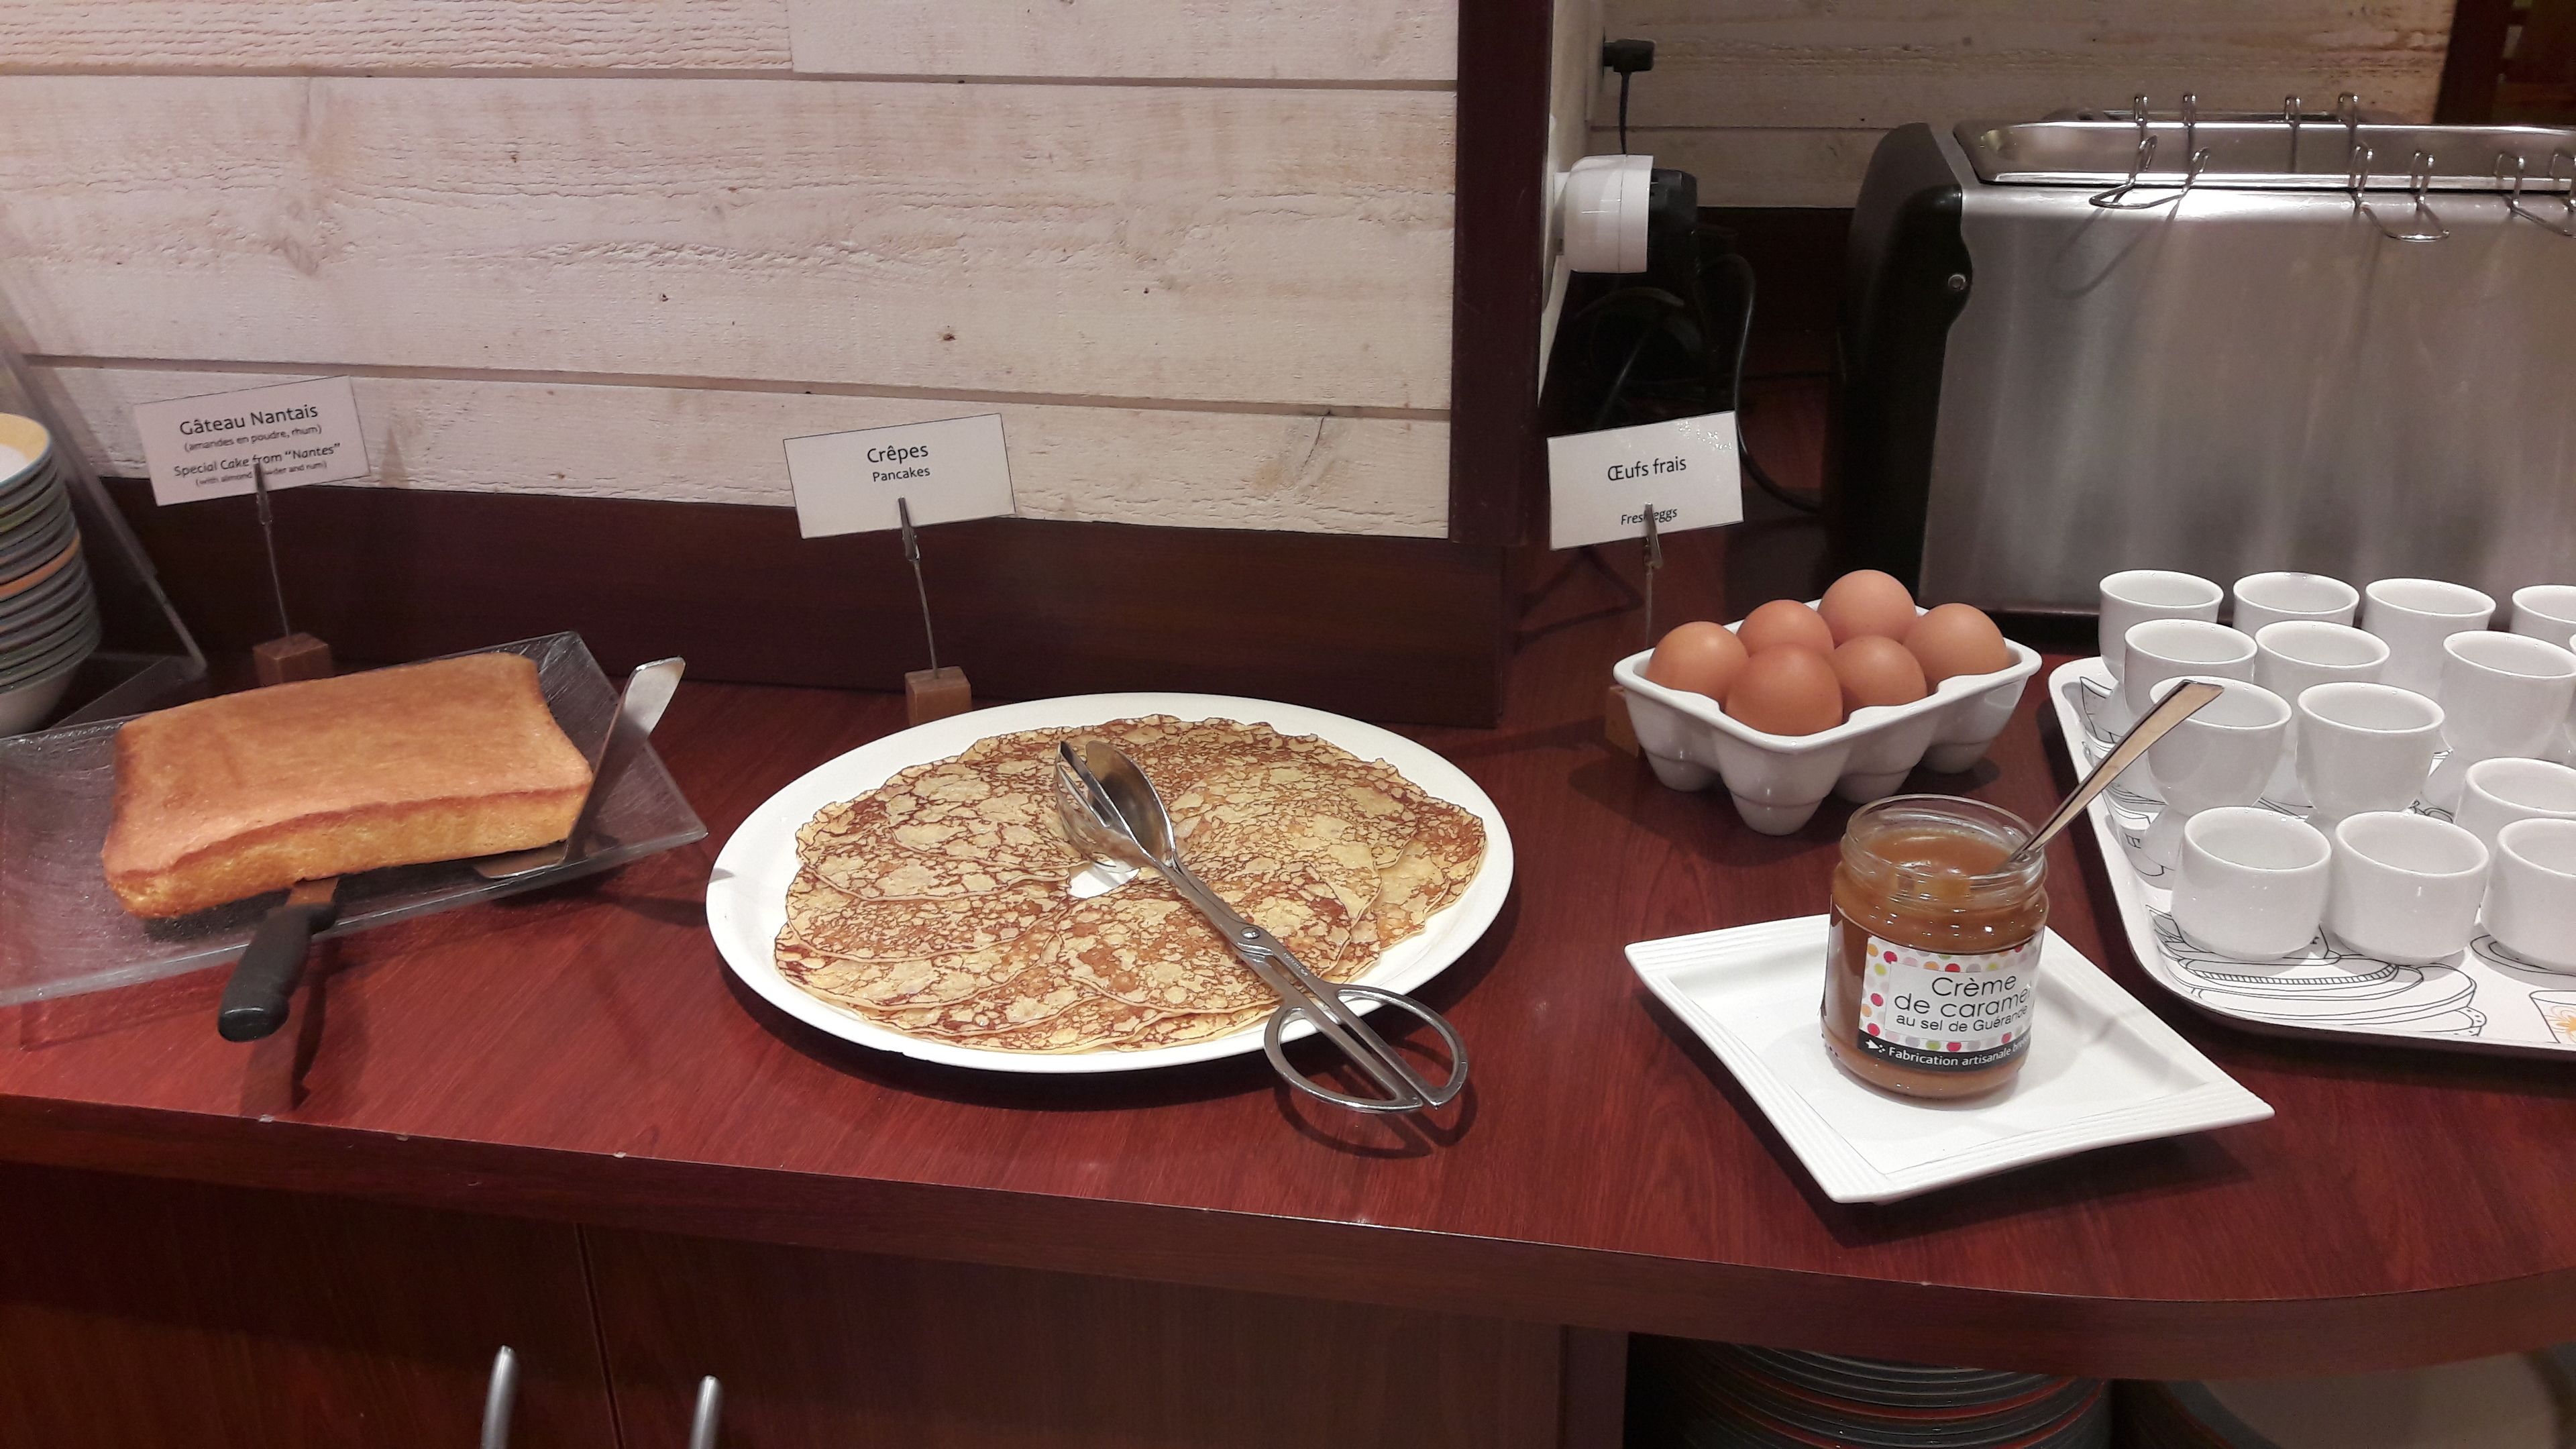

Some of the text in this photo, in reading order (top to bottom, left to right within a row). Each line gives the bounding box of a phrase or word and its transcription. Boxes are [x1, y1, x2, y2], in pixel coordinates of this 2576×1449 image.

[179, 404, 319, 437] Gâteau Nantais
[867, 444, 929, 464] Crêpes
[174, 461, 217, 478] Special
[220, 458, 250, 470] Cake
[252, 454, 282, 466] from
[872, 467, 930, 482] Pancakes
[1652, 455, 1687, 475] frais
[1621, 507, 1678, 525] Fres eggs
[1931, 975, 2017, 998] Crème
[1894, 993, 1931, 1014] de
[1896, 1014, 1916, 1027] au
[1920, 1019, 1943, 1031] sel
[1948, 1020, 1968, 1032] de
[1888, 1046, 2012, 1067] Fabrication artisanale
